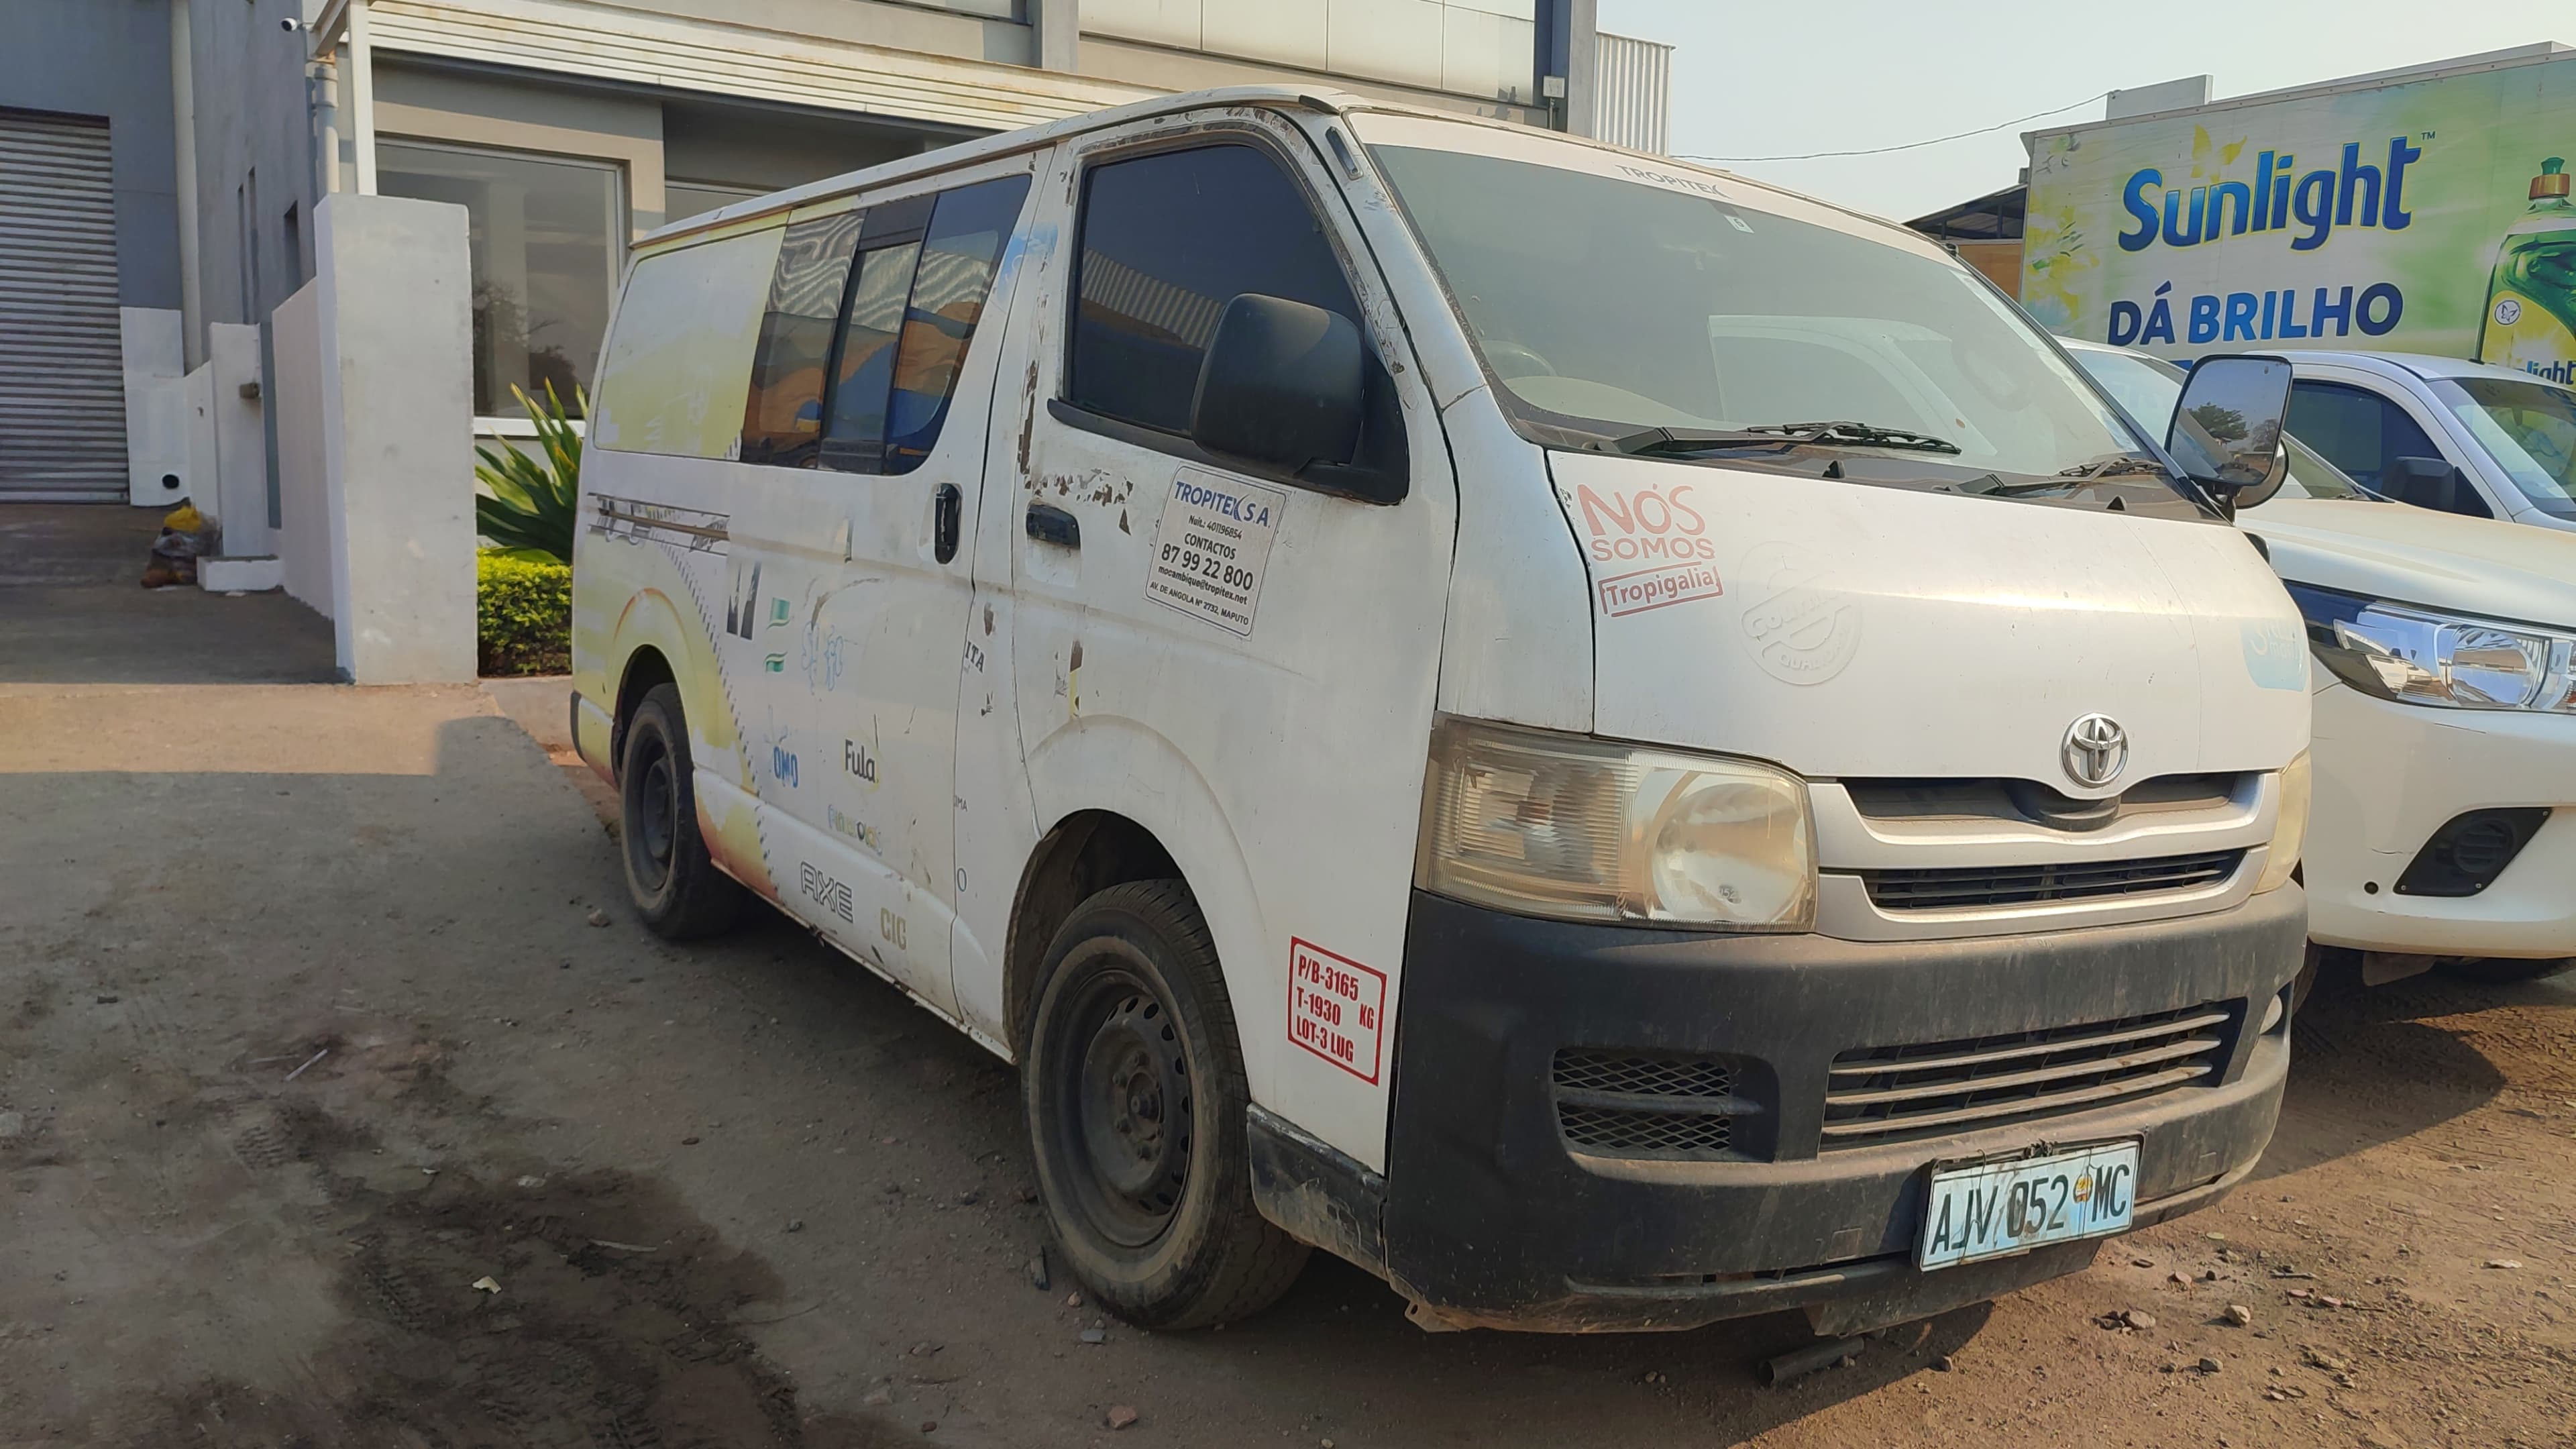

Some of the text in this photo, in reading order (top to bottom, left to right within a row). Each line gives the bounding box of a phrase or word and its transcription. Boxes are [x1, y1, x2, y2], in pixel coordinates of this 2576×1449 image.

[1615, 164, 1733, 199] TROPITEX
[2118, 136, 2422, 251] Sunlight
[2108, 280, 2404, 346] DÁ BRILHO
[1174, 481, 1271, 529] TROPITEX S.A.
[1577, 483, 1706, 536] NÓS
[1185, 533, 1236, 560] CONTACTOS
[1207, 521, 1243, 541] 401196854
[1591, 537, 1716, 561] SOMOS
[1161, 543, 1253, 591] 87 99 22 800
[1607, 566, 1715, 606] Tropigalia
[1150, 582, 1159, 592] AV.
[1160, 584, 1169, 594] DE
[1169, 589, 1195, 604] ANGOLA
[1220, 608, 1249, 626] MAPUTO
[773, 746, 798, 788] OMO
[845, 739, 875, 784] Fula
[801, 861, 853, 924] AXE
[1297, 954, 1359, 1002] P/B-3165
[1296, 985, 1342, 1026] T-1930
[1358, 1003, 1375, 1031] KG
[1296, 1014, 1354, 1063] LOT-3 LUG
[1929, 1163, 2130, 1256] AJV 052 MC
